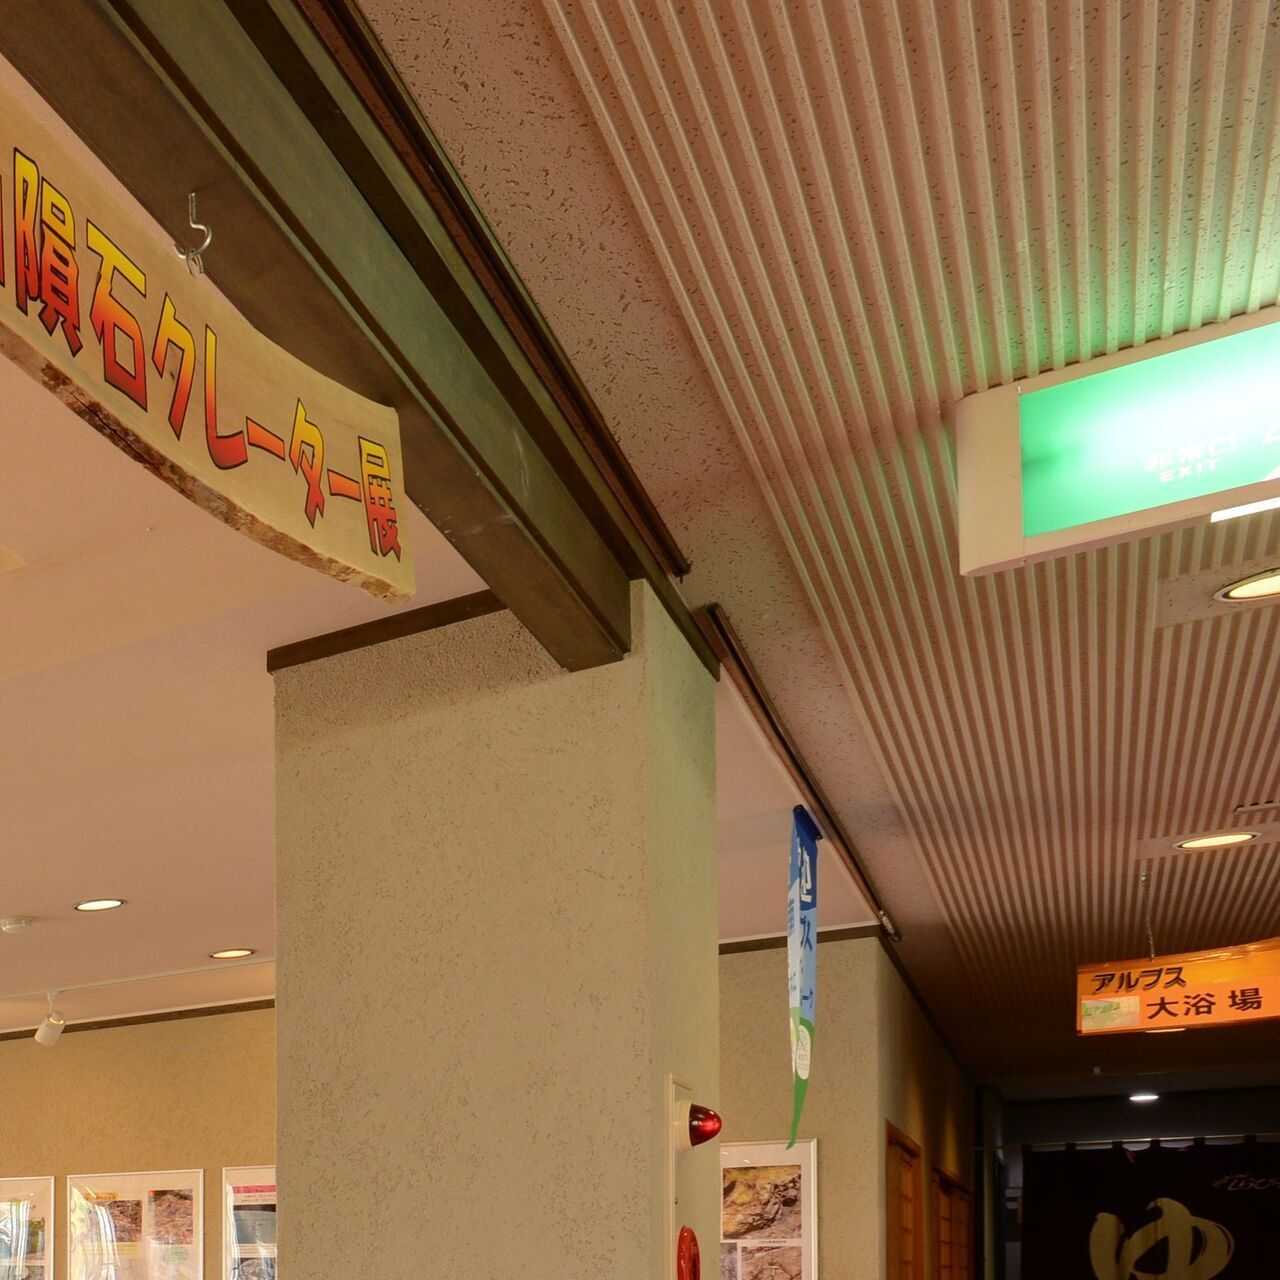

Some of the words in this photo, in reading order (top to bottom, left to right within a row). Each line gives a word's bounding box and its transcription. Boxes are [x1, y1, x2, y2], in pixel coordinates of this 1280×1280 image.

[1159, 458, 1220, 483] EXIT
[1093, 966, 1187, 994] アルプス
[1146, 987, 1263, 1020] 大浴場
